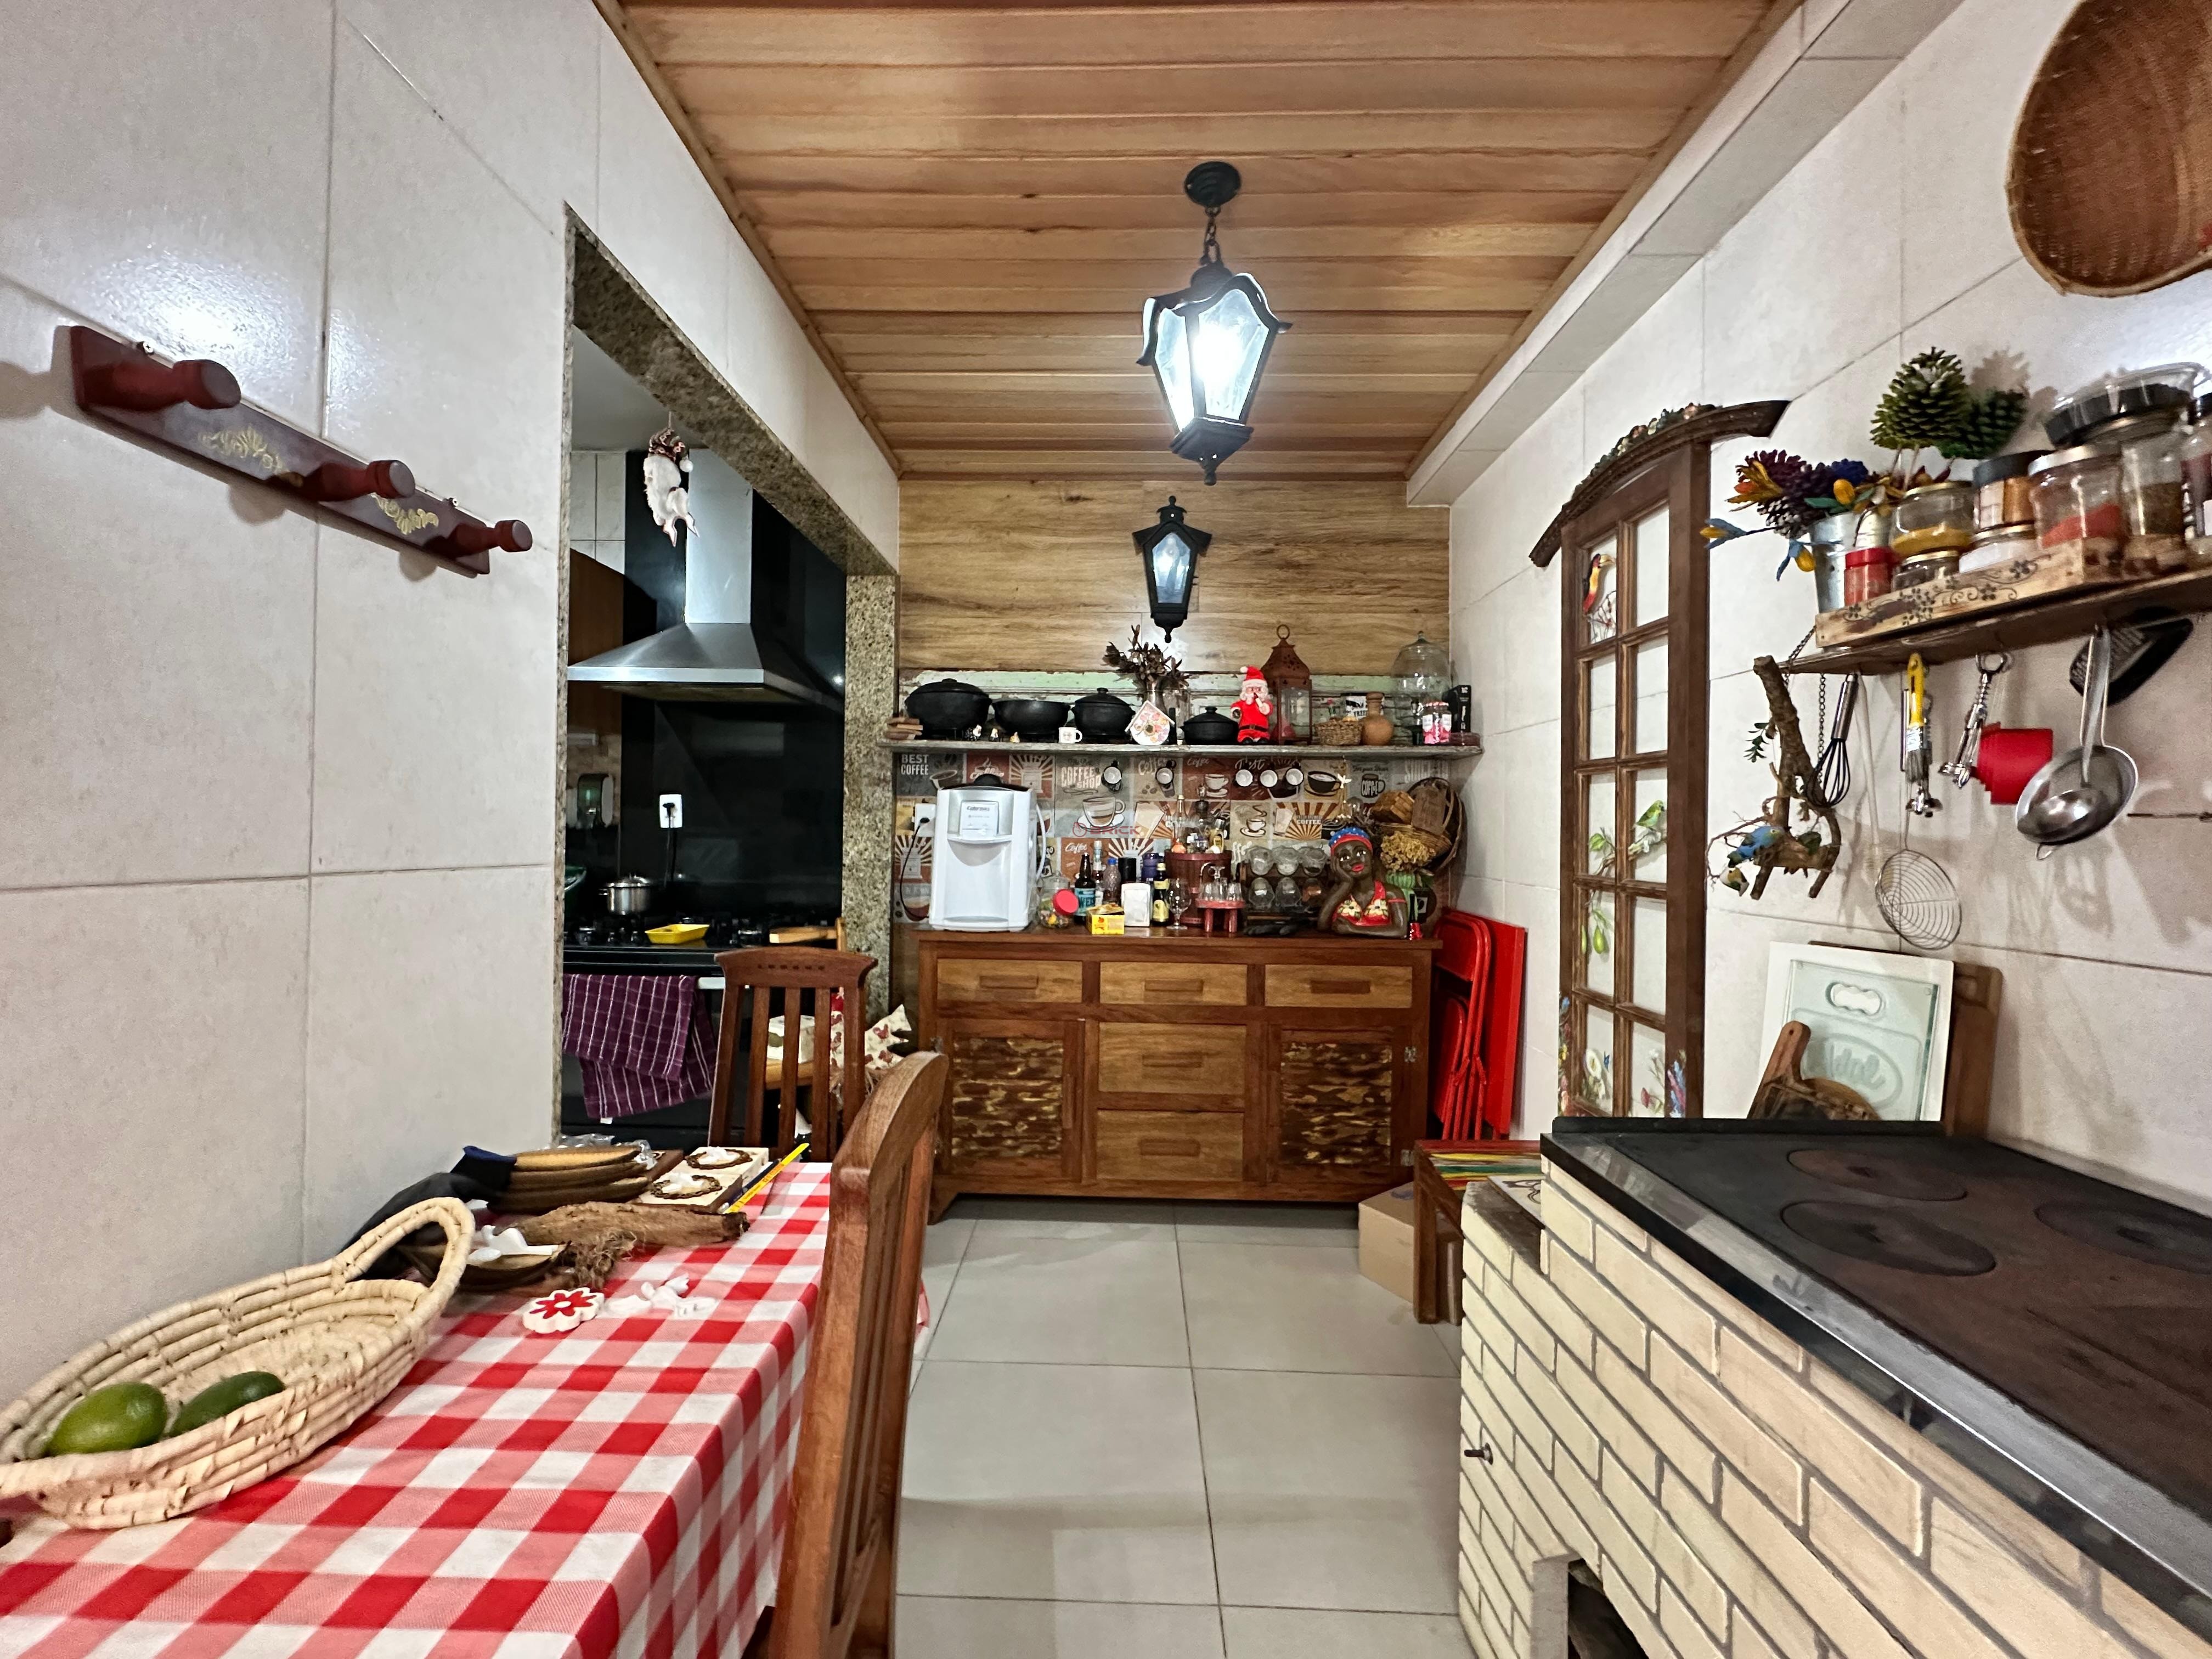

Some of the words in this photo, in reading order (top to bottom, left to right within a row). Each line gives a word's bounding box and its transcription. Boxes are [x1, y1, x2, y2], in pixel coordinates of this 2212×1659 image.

[901, 754, 929, 764] BEST
[900, 764, 929, 775] COFFEE
[1061, 766, 1095, 788] COFFEE
[1076, 774, 1102, 789] SHOP
